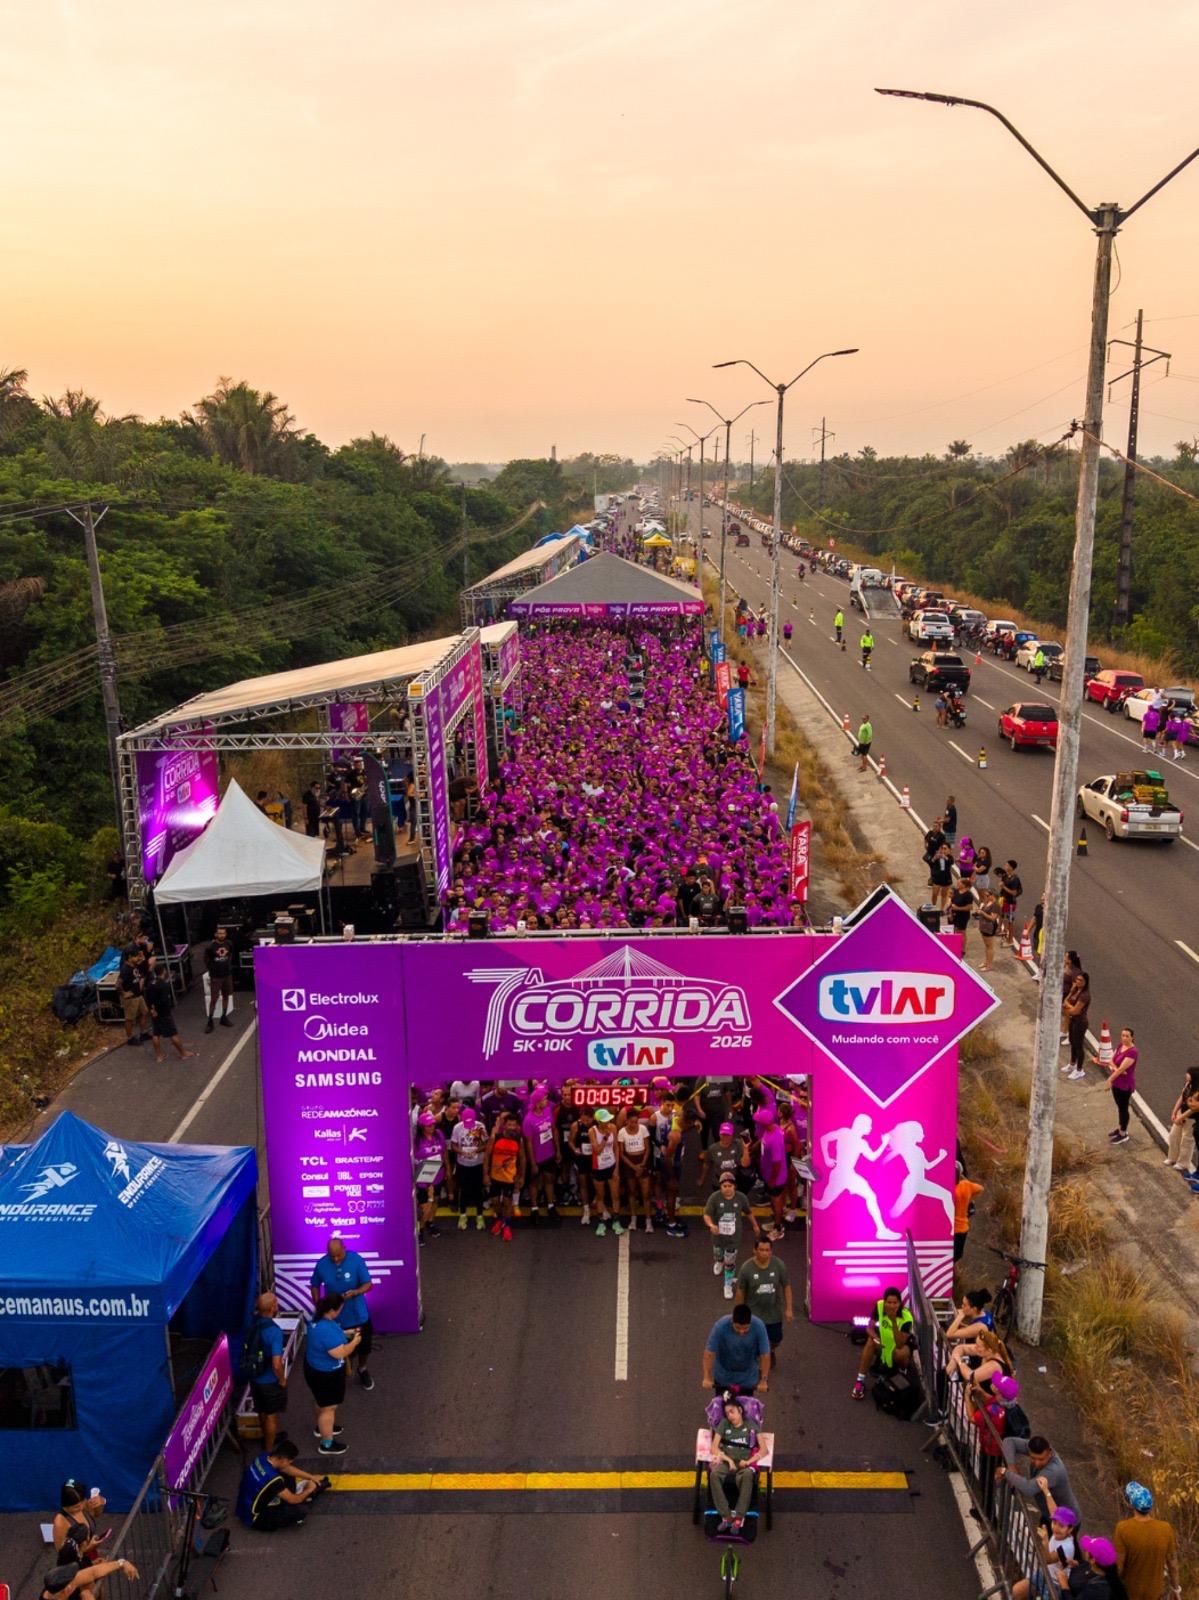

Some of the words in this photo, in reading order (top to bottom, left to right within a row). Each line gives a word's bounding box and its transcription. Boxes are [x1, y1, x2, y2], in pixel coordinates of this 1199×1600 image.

[797, 826, 809, 865] YARA
[310, 992, 379, 1005] Electrolux
[510, 987, 751, 1034] CORRIDA
[709, 1035, 753, 1048] 2026
[831, 1034, 885, 1044] Mudando
[886, 1036, 911, 1044] com
[912, 1034, 940, 1044] você
[297, 1048, 377, 1063] MONDIAL
[295, 1072, 382, 1088] SAMSUNG
[574, 1088, 648, 1106] 00:05:27
[313, 1128, 342, 1138] Kallas
[299, 1155, 328, 1166] TCL
[334, 1155, 384, 1164] BRASTEMP
[118, 1155, 163, 1205] ENDURANCE
[301, 1172, 329, 1180] Consul
[0, 1294, 150, 1317] cemanaus.com.br
